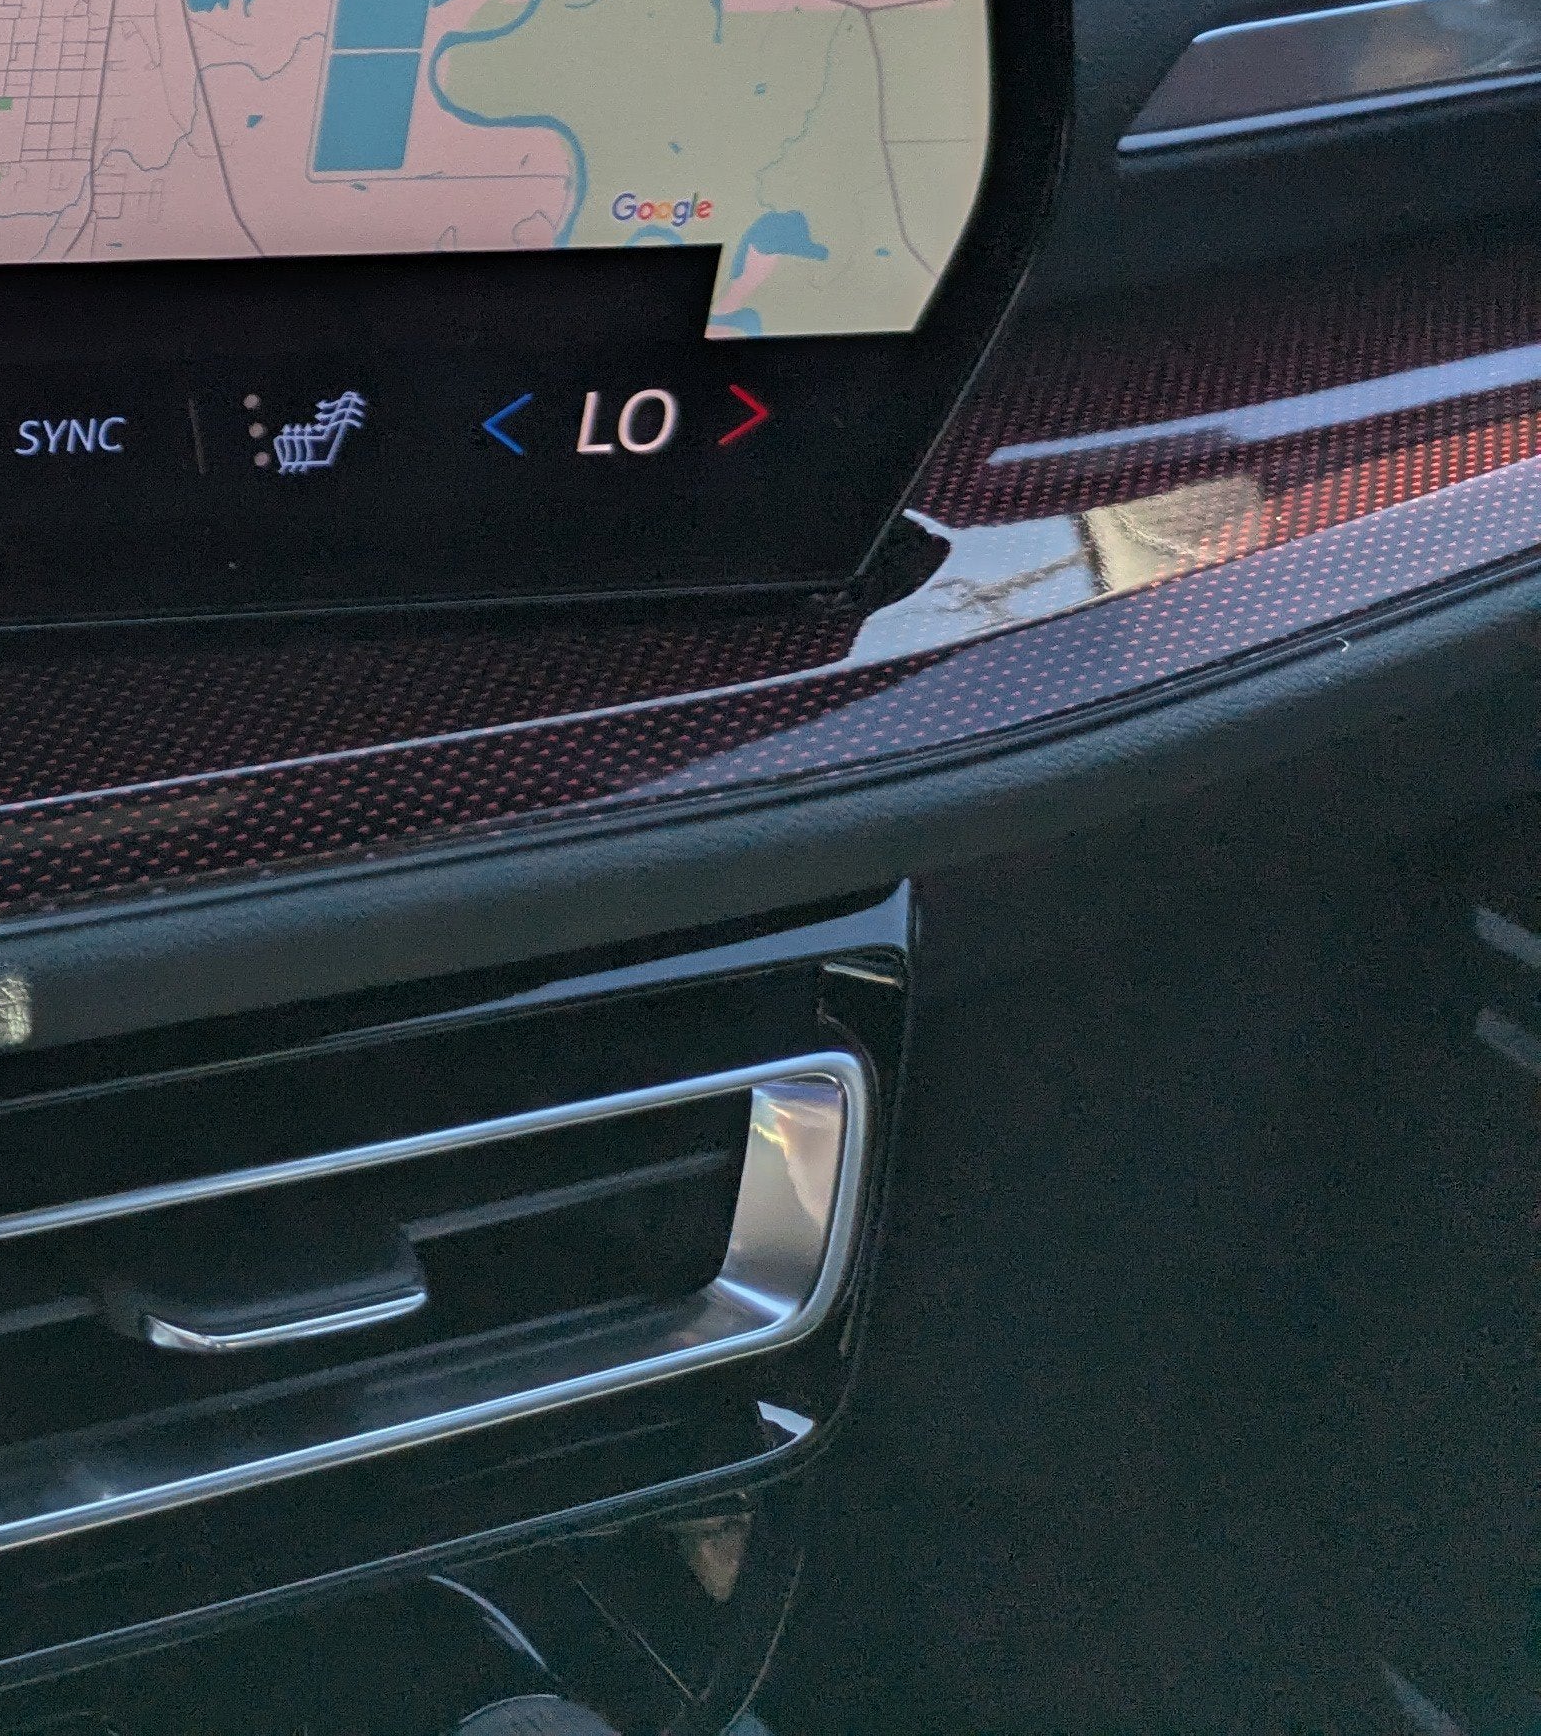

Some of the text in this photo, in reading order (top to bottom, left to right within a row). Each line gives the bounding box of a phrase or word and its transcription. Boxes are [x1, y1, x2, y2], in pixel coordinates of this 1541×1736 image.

[611, 190, 714, 228] Google
[14, 415, 126, 457] SYNC
[576, 387, 677, 455] LO
